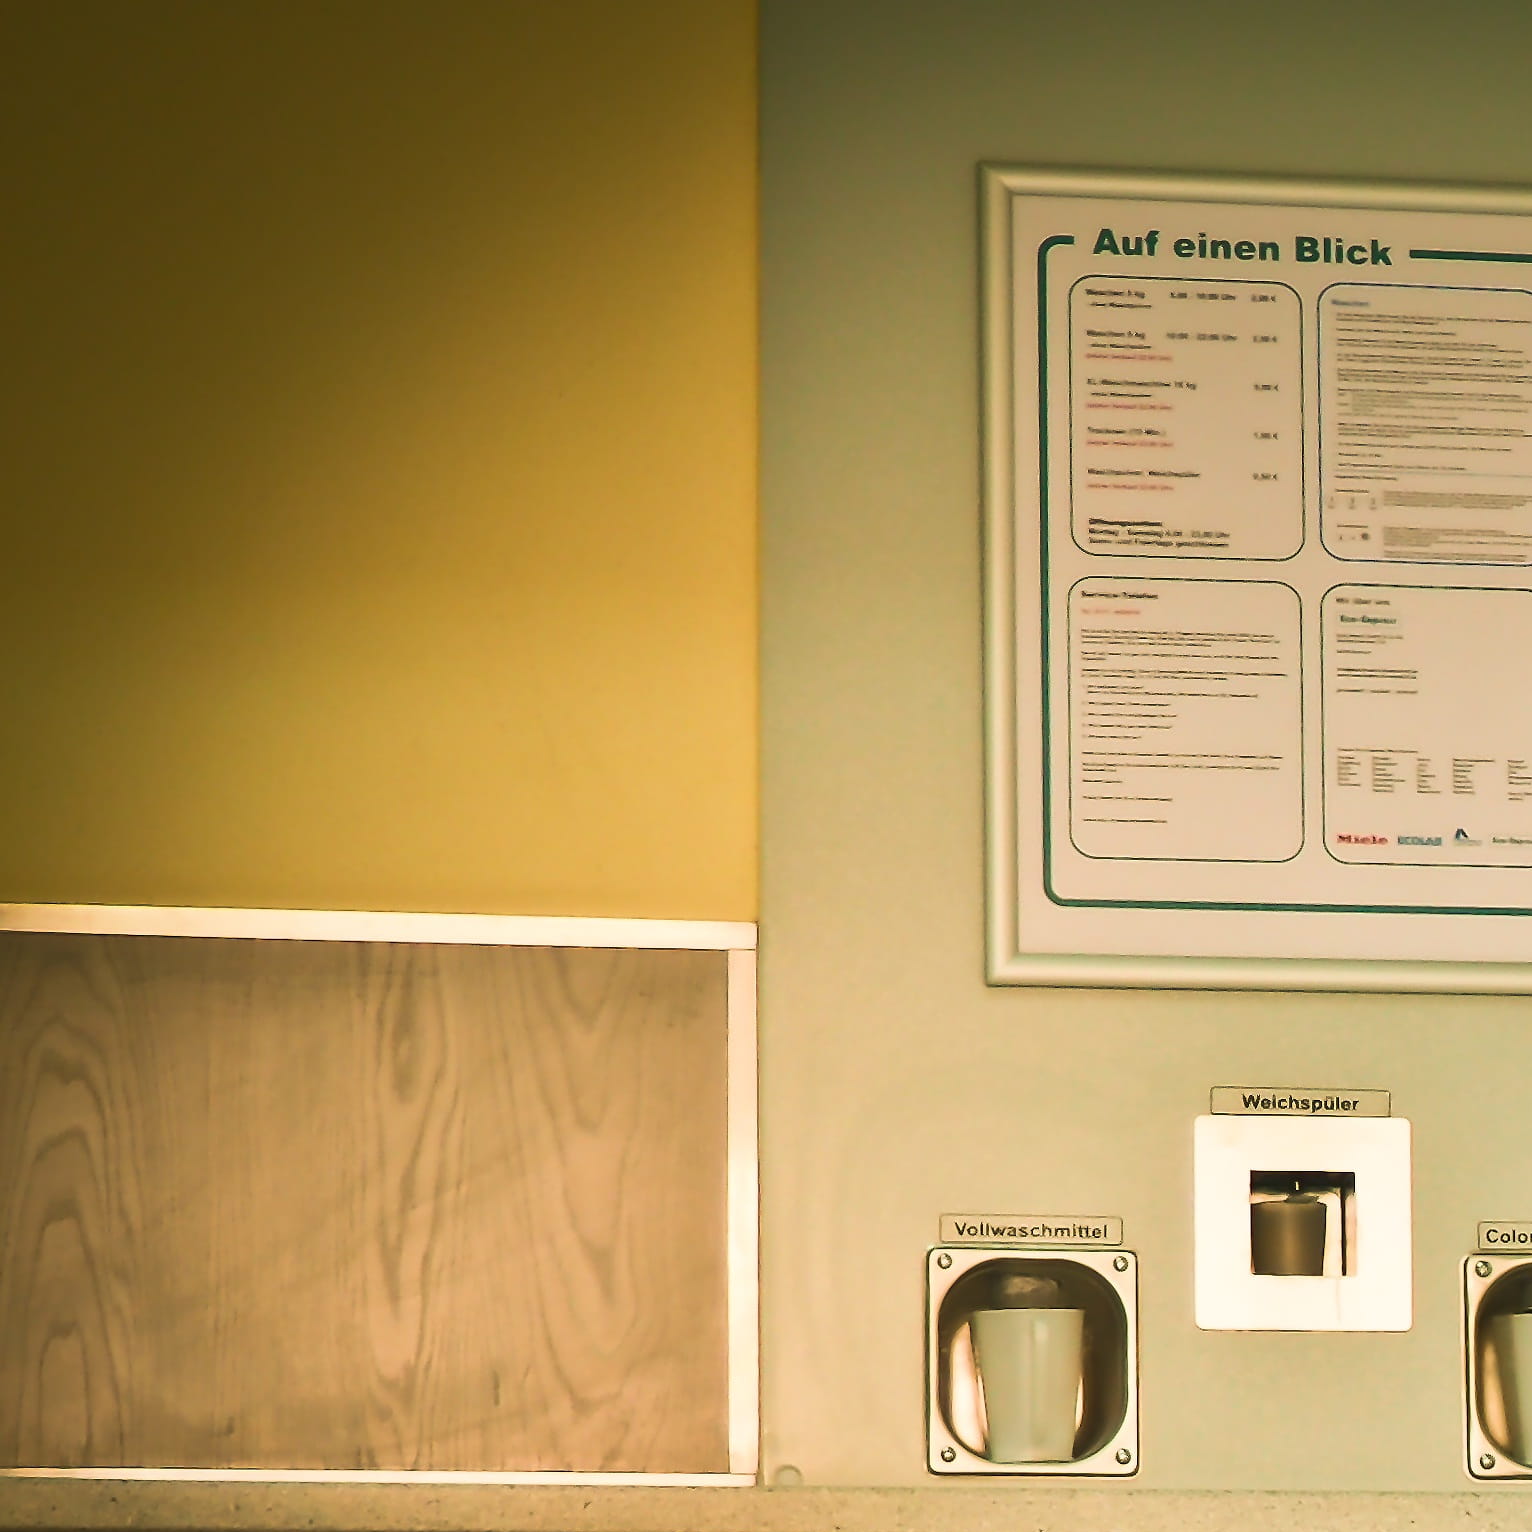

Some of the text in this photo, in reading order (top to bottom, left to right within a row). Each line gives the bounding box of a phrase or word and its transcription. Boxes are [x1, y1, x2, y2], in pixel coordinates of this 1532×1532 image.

[1092, 228, 1393, 265] Auf einen Blick
[1337, 833, 1389, 845] Miele
[1242, 1091, 1359, 1114] Weichspüler
[954, 1220, 1109, 1240] Vollwaschmittel
